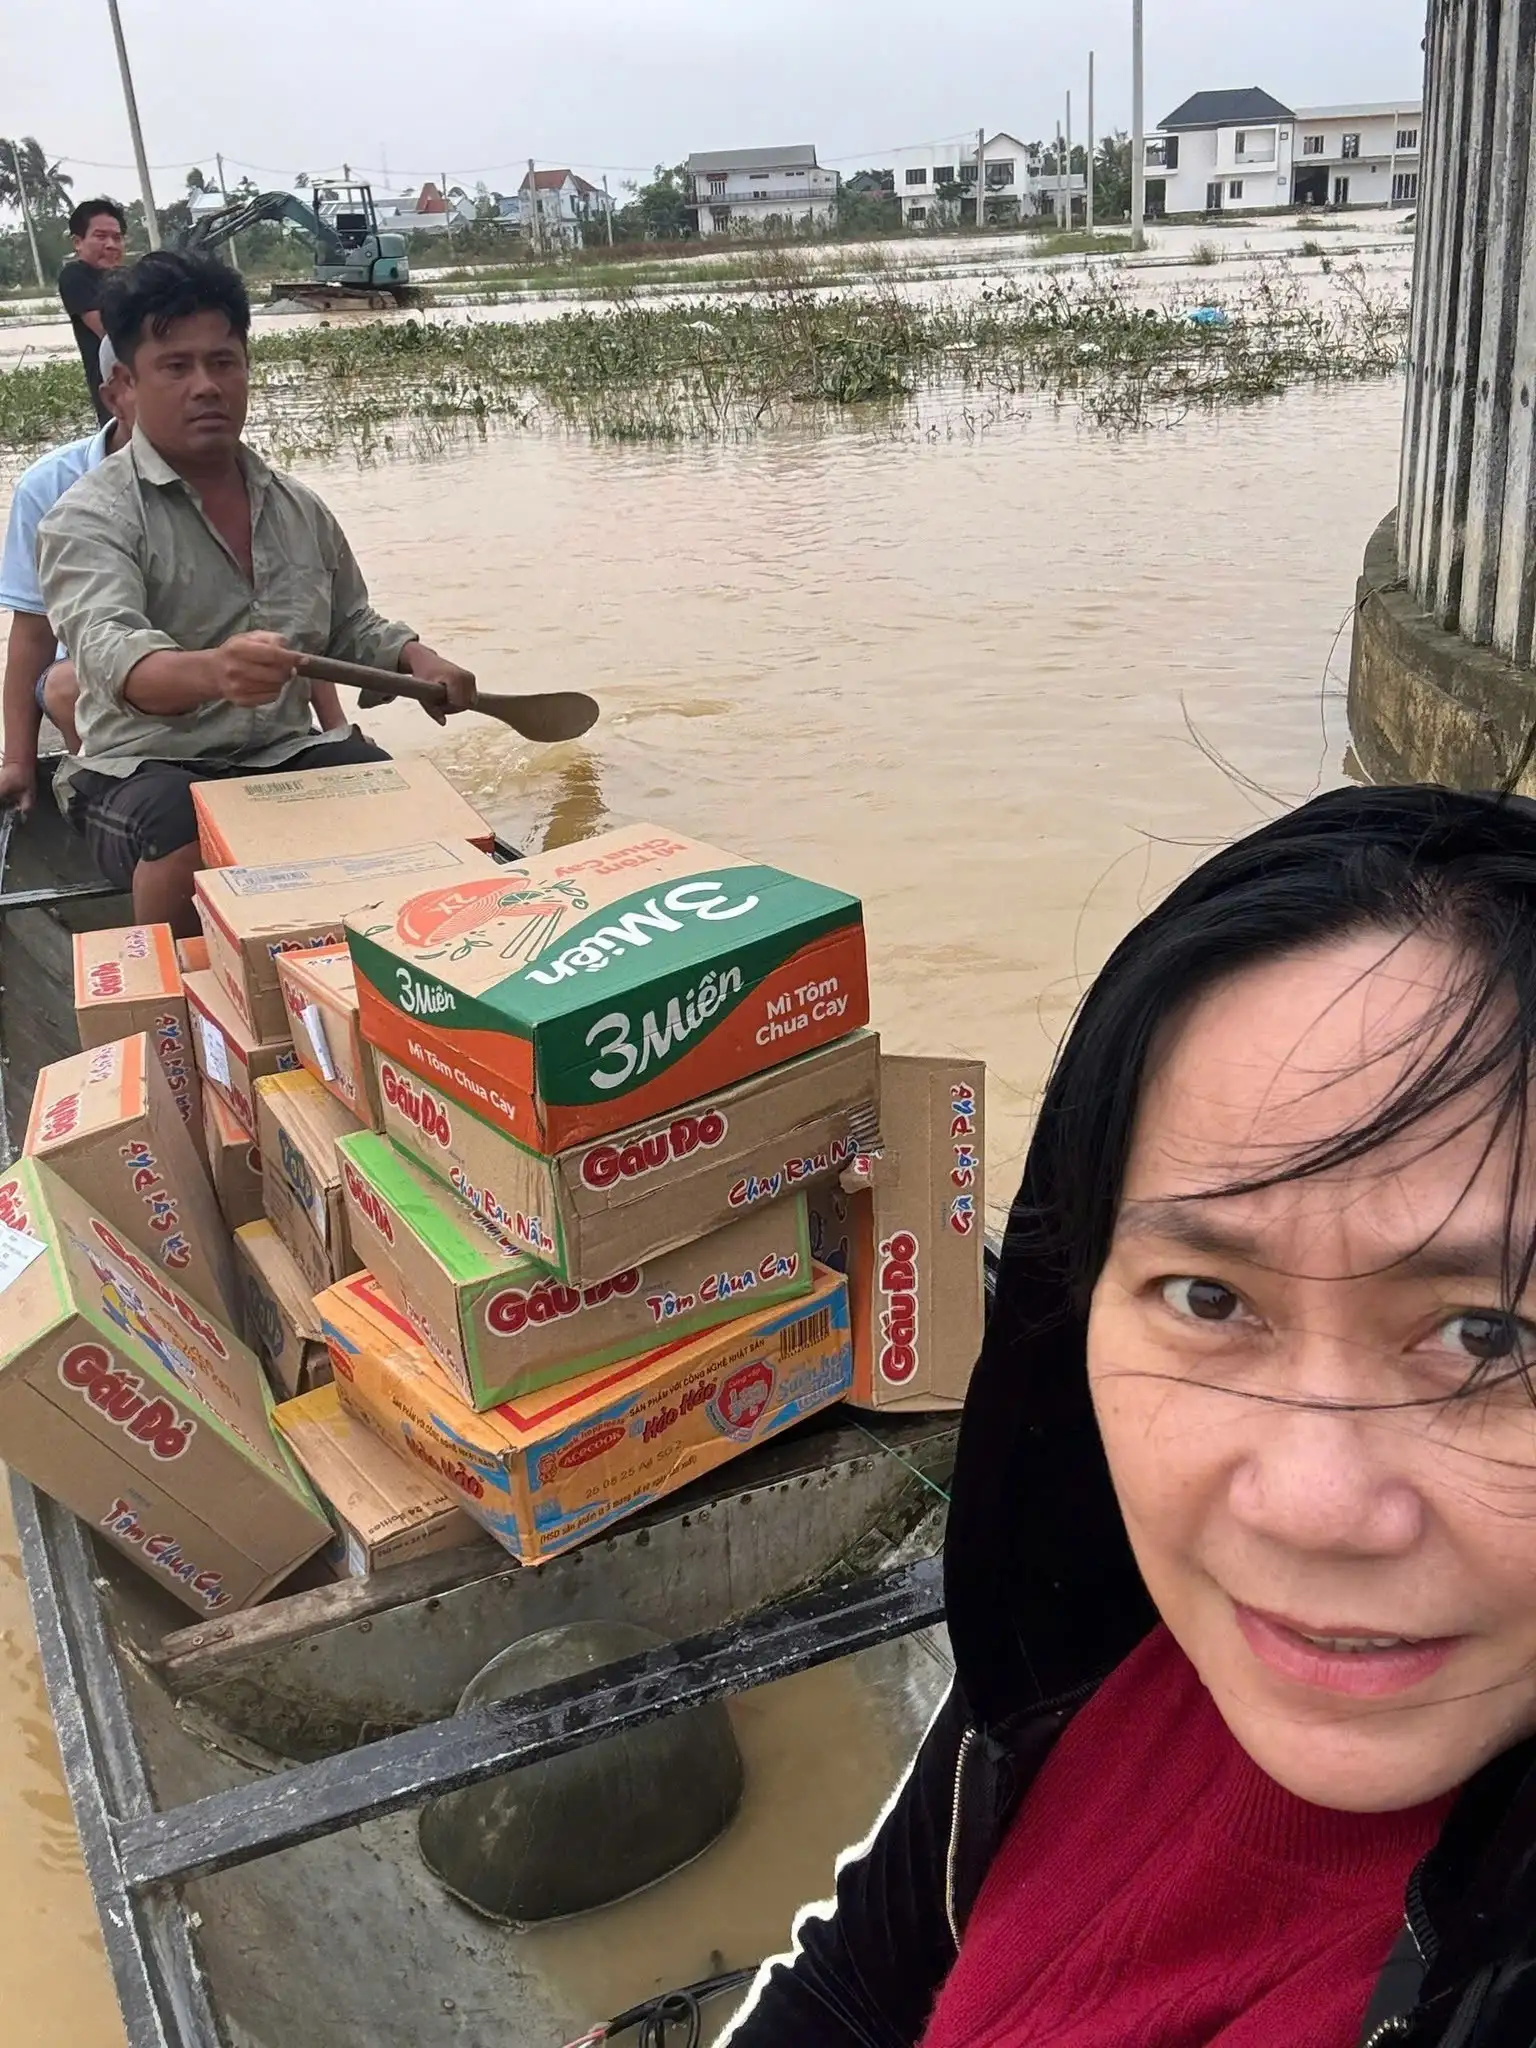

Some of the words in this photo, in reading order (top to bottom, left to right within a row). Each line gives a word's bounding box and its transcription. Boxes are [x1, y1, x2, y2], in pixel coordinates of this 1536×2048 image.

[554, 859, 605, 879] Cay
[593, 857, 656, 876] Tôm
[604, 838, 670, 859] Chua
[755, 1014, 809, 1046] Chua
[812, 994, 848, 1022] Cay
[767, 999, 792, 1020] Mì
[794, 977, 838, 1006] Tôm
[408, 1039, 424, 1062] Mì
[424, 1049, 452, 1079] Tôm
[454, 1068, 488, 1102] Chua
[490, 1090, 515, 1120] Cay
[949, 1081, 977, 1138] Phở
[729, 1172, 781, 1207] Chay
[785, 1154, 828, 1185] Rau
[950, 1144, 979, 1188] Sợi
[450, 1167, 481, 1209] Chay
[484, 1189, 515, 1233] Rau
[516, 1211, 554, 1252] Nấm
[950, 1195, 976, 1234] Gà
[647, 1289, 695, 1321] Tôm
[700, 1268, 756, 1303] Chua
[760, 1252, 799, 1287] Cay
[100, 1498, 146, 1543] Tôm
